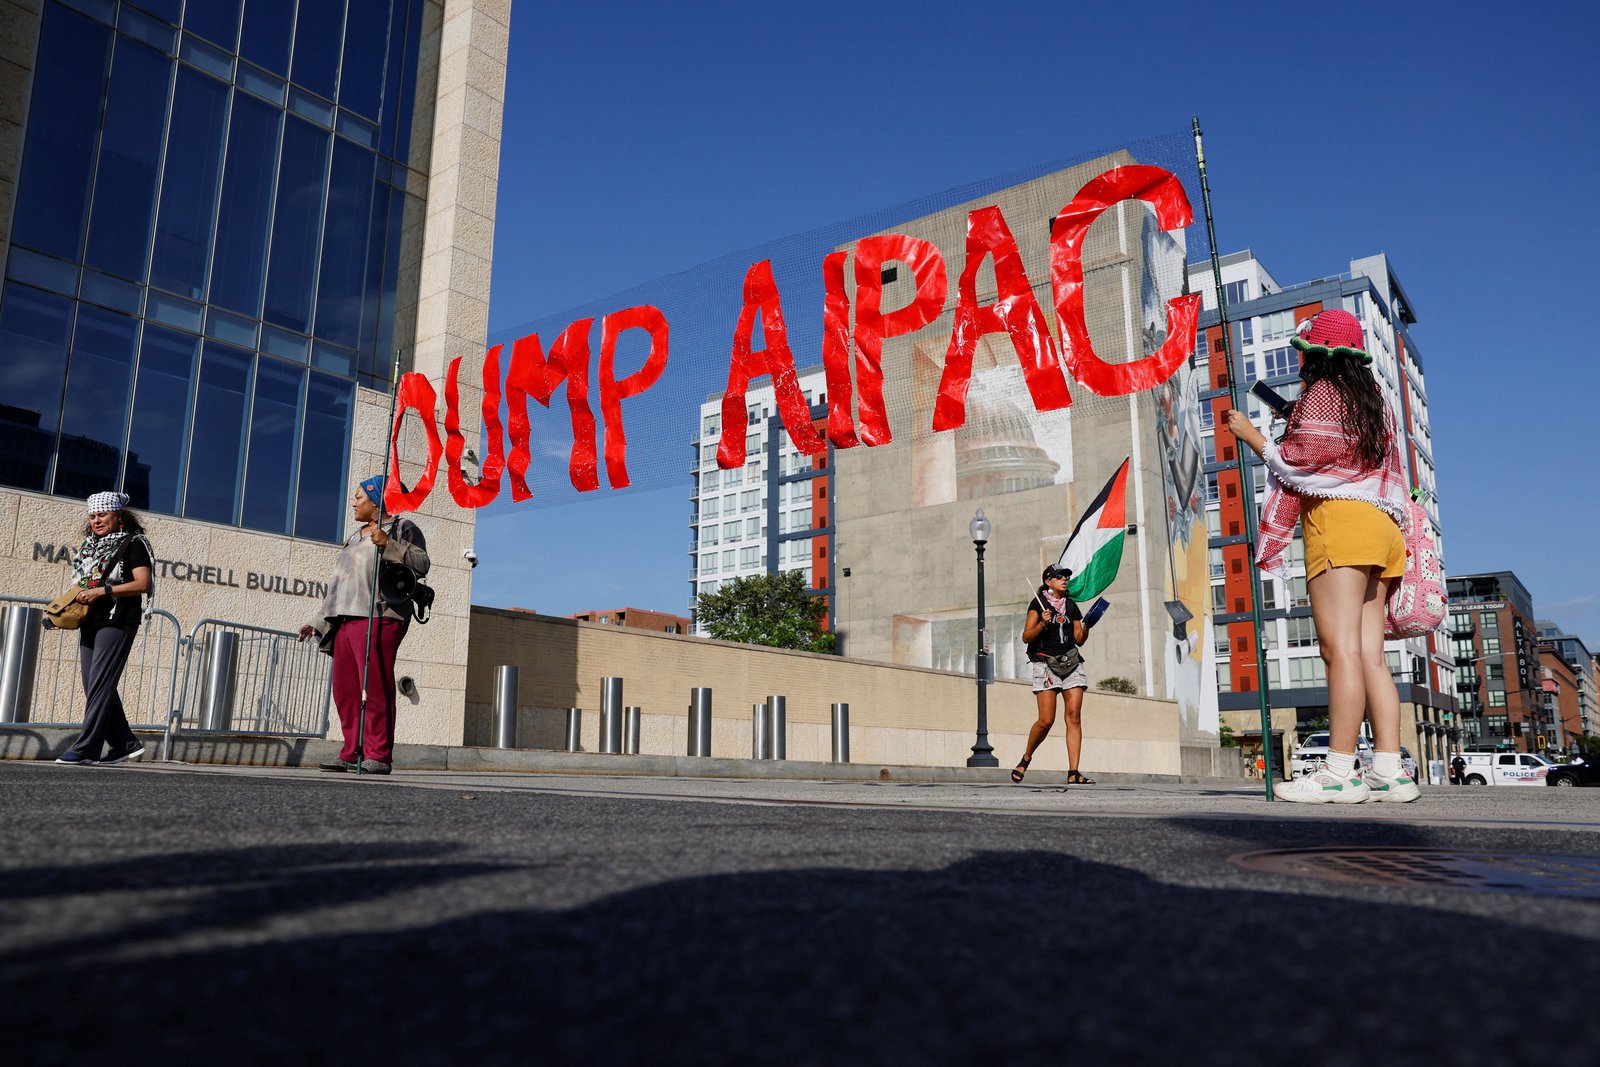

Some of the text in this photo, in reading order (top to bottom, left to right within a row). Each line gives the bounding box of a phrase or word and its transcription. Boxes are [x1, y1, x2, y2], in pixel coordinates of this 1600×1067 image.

[384, 164, 1201, 515] DUMP AIPAC
[154, 558, 240, 588] TCHELL
[246, 571, 329, 600] BUILDIN
[1515, 621, 1527, 684] ALTA 801
